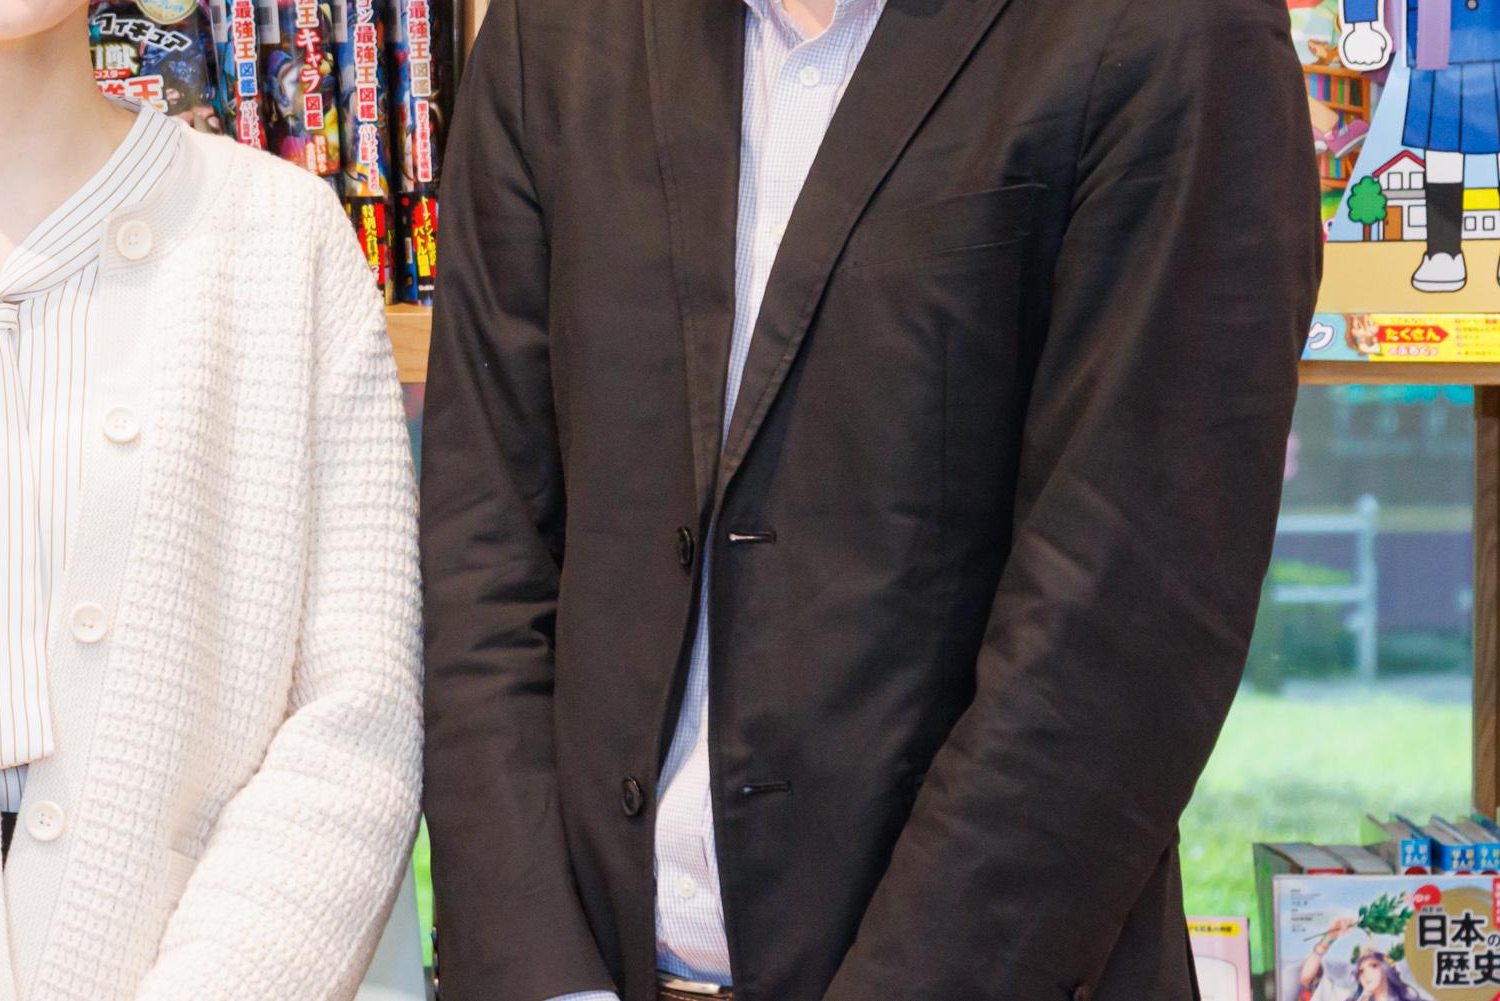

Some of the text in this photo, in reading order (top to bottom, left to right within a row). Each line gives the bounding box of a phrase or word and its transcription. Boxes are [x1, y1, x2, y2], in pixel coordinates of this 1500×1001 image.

[1385, 327, 1441, 342] たくさん
[1435, 950, 1500, 986] 歴史
